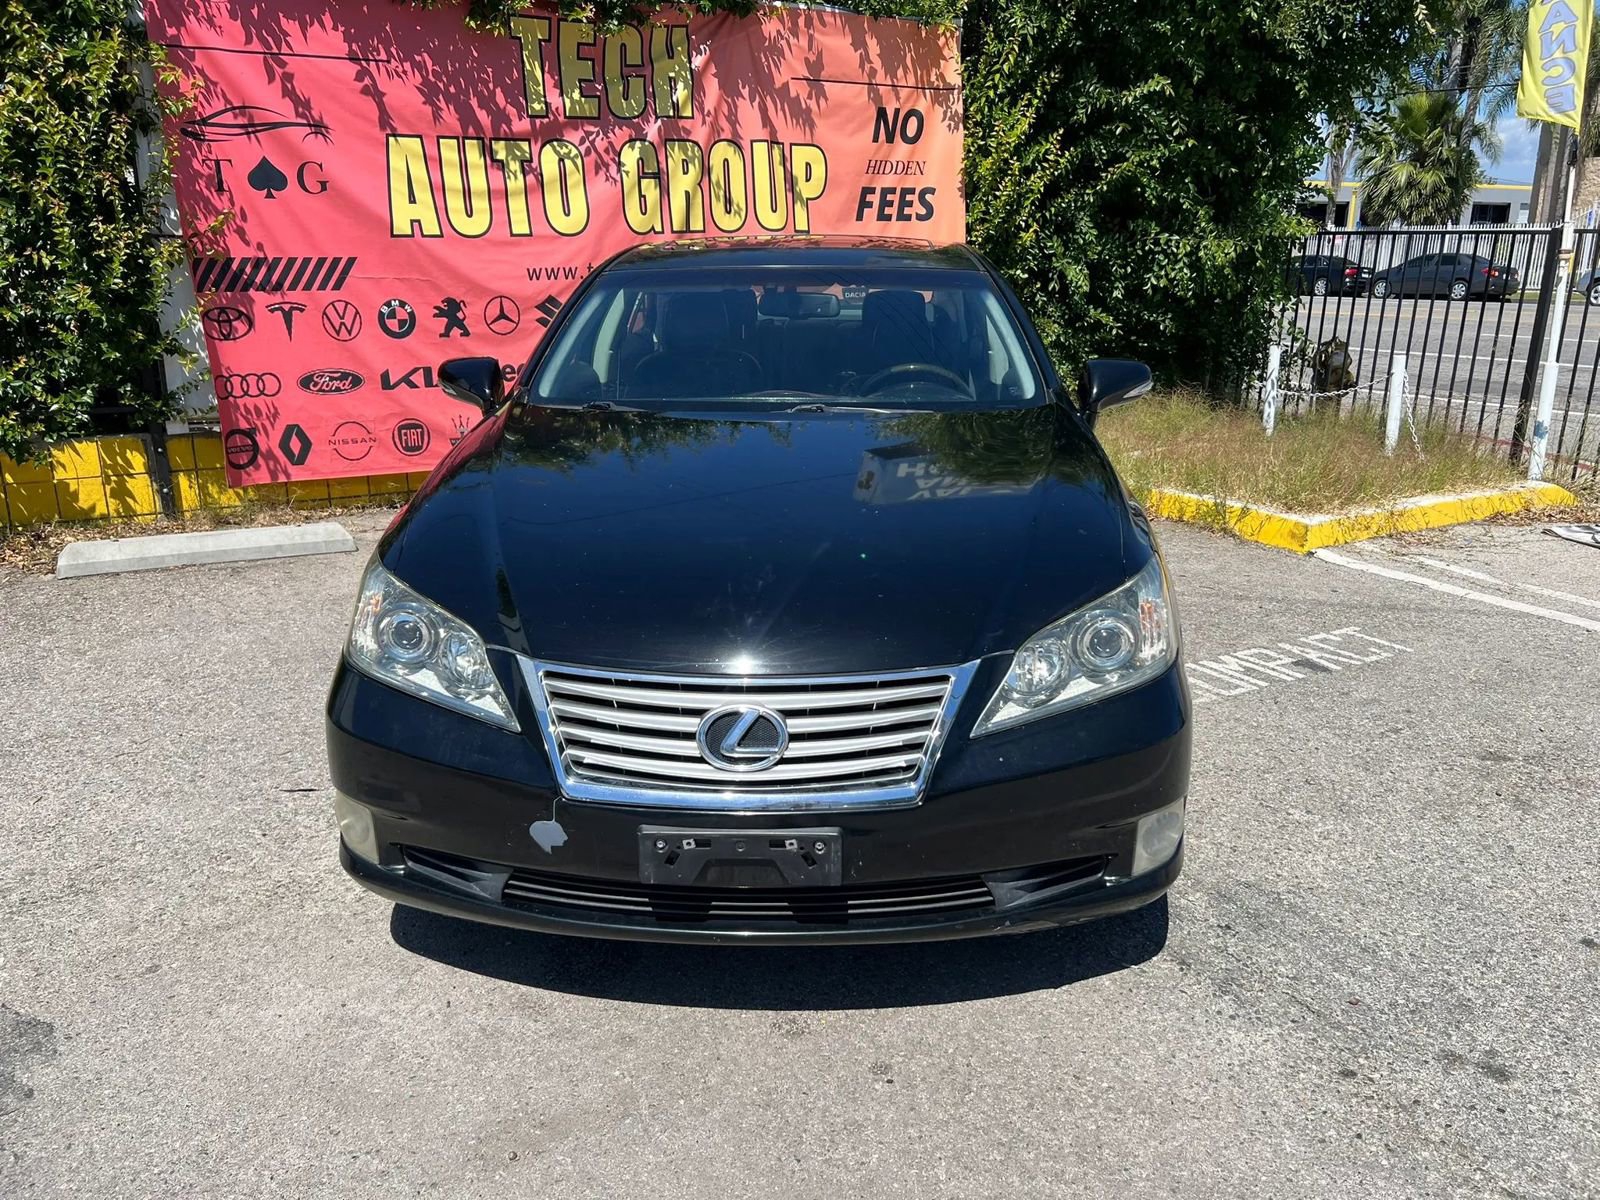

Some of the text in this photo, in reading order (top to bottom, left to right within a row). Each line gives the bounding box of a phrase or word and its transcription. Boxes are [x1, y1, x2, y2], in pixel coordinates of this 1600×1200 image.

[509, 14, 694, 119] TECH
[872, 106, 925, 145] NO
[865, 159, 927, 176] HIDDEN
[385, 134, 828, 238] AUTO GROUP
[855, 186, 937, 222] FEES
[310, 372, 353, 391] Ford
[380, 366, 439, 391] KI
[328, 436, 377, 446] NISSAN
[401, 428, 422, 447] FIAT
[1184, 626, 1414, 703] OMPACT
